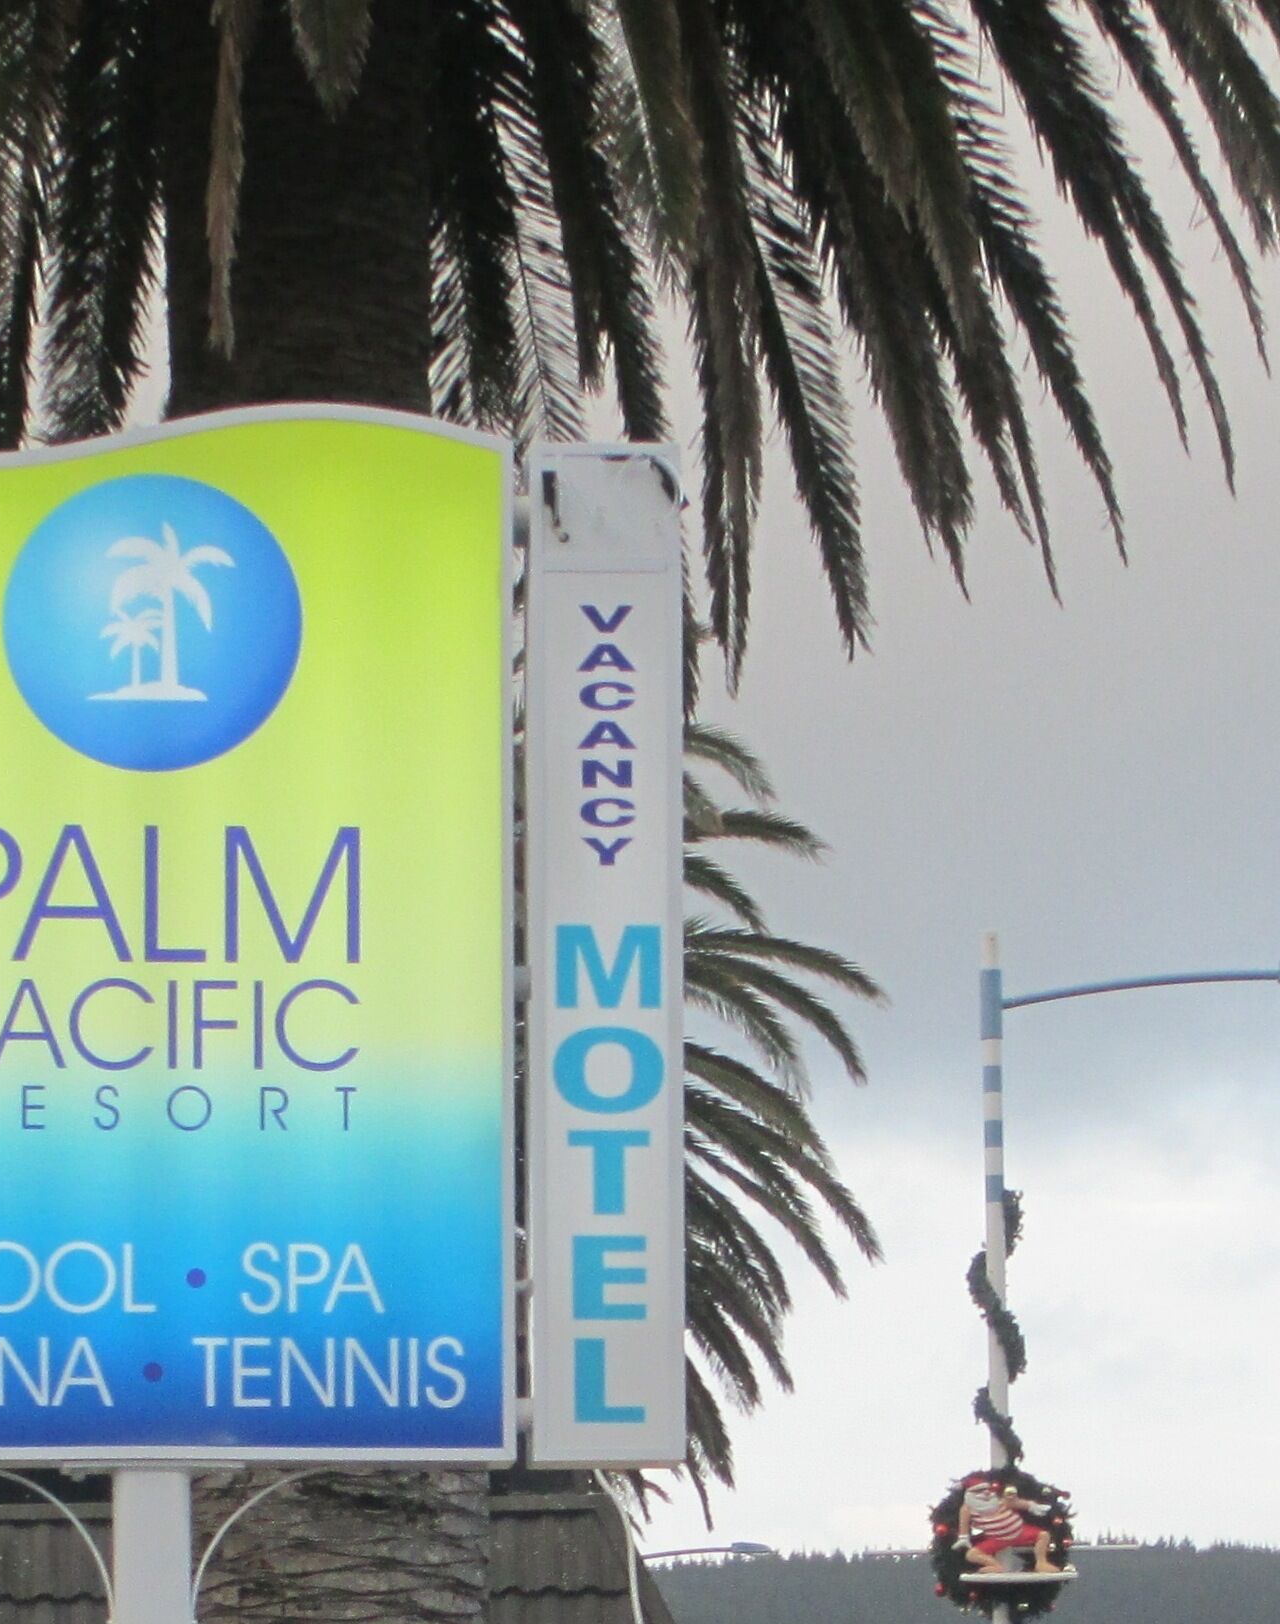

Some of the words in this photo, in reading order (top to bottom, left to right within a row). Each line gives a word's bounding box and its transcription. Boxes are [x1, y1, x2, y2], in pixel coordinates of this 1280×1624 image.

[578, 604, 636, 867] VACANCY
[552, 923, 665, 1425] MOTEL
[240, 1242, 385, 1315] SPA
[191, 1336, 467, 1410] TENNIS
